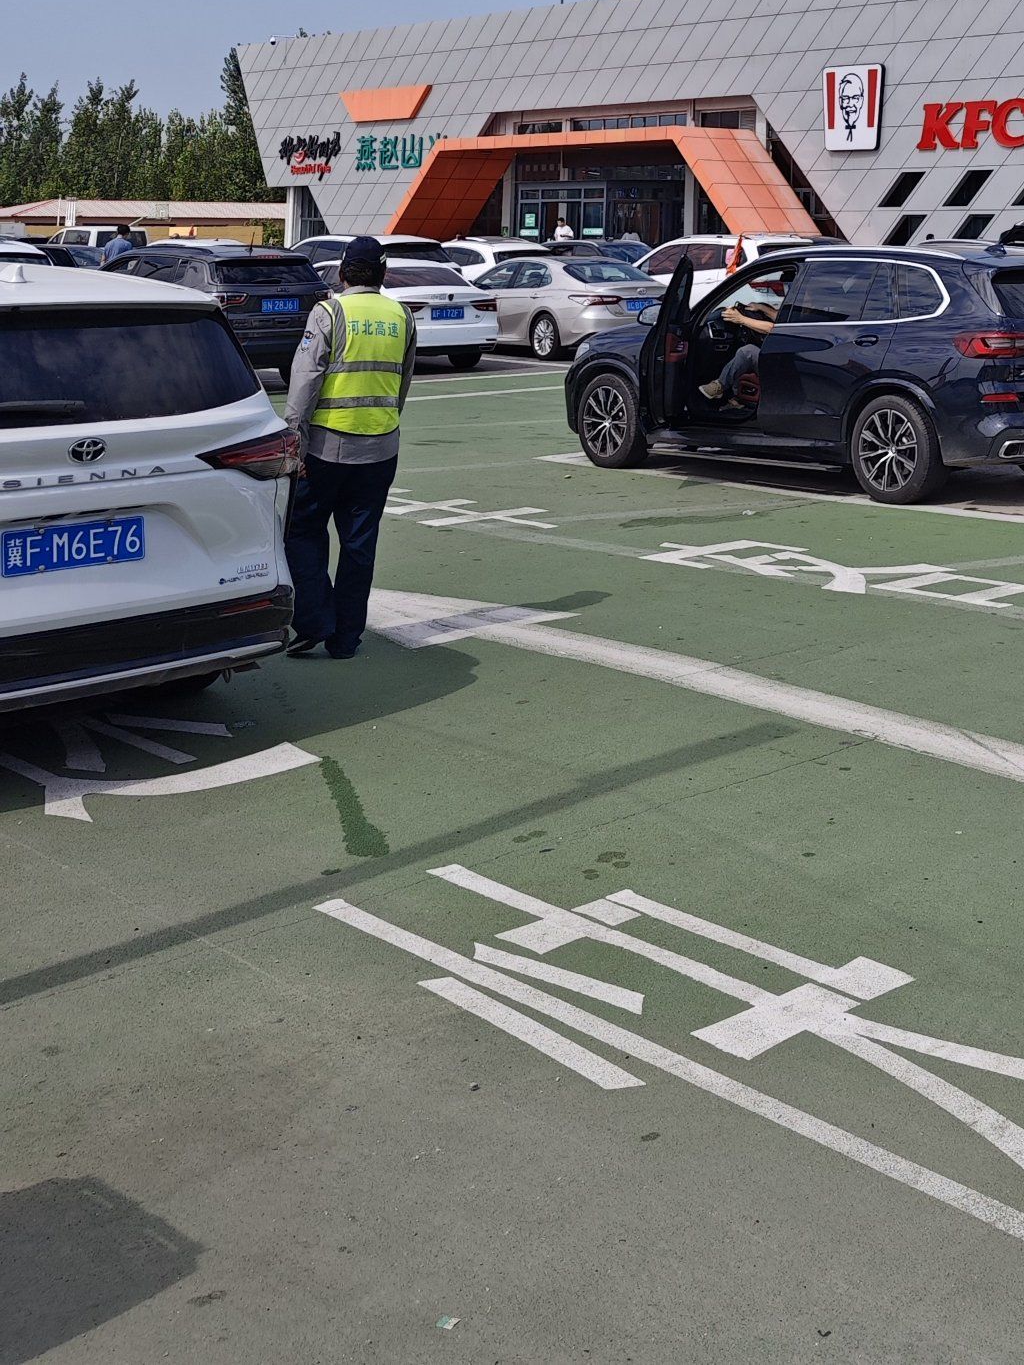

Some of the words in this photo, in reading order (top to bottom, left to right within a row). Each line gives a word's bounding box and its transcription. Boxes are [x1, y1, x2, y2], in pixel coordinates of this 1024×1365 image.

[347, 319, 400, 338] 河北高速
[0, 465, 167, 489] SIENNA
